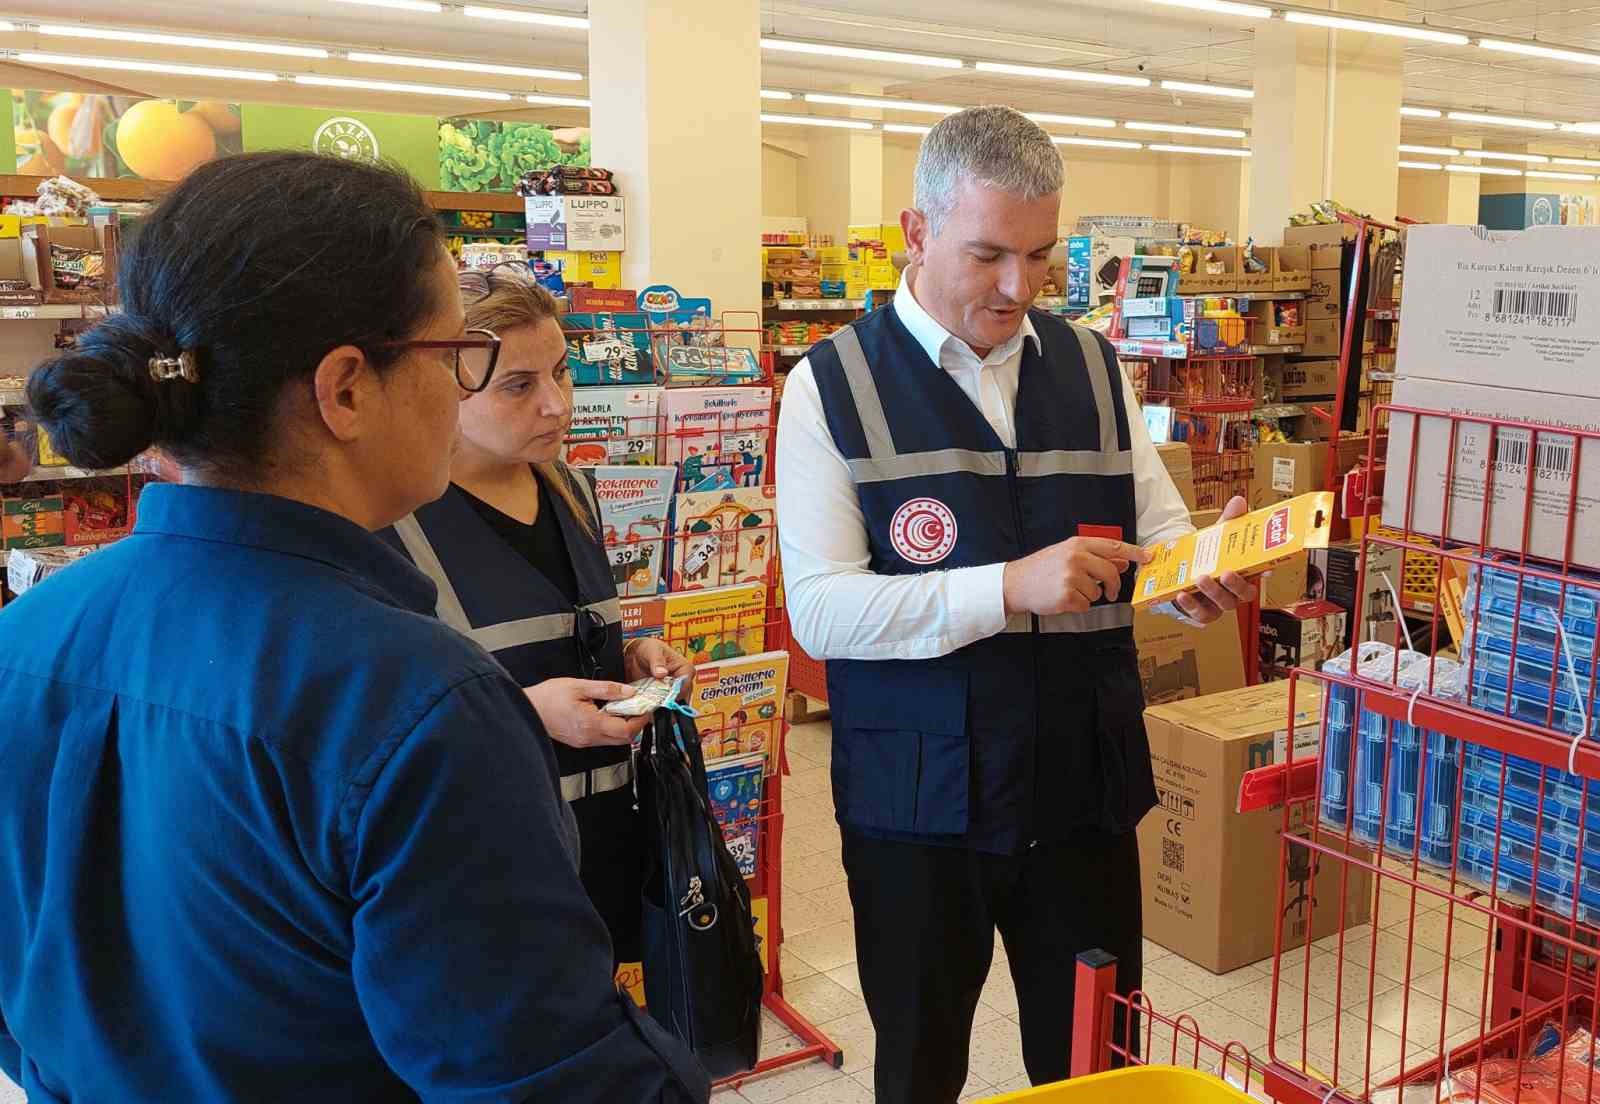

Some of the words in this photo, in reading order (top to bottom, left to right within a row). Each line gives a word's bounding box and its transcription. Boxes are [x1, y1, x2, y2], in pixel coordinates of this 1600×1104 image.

[322, 123, 369, 142] TAZE
[570, 199, 609, 209] LUPPO
[605, 346, 621, 359] 29
[627, 439, 644, 453] 29
[738, 439, 754, 452] 34
[616, 551, 632, 564] 39
[699, 544, 714, 561] 34
[1167, 818, 1181, 836] CE
[730, 843, 744, 856] 39
